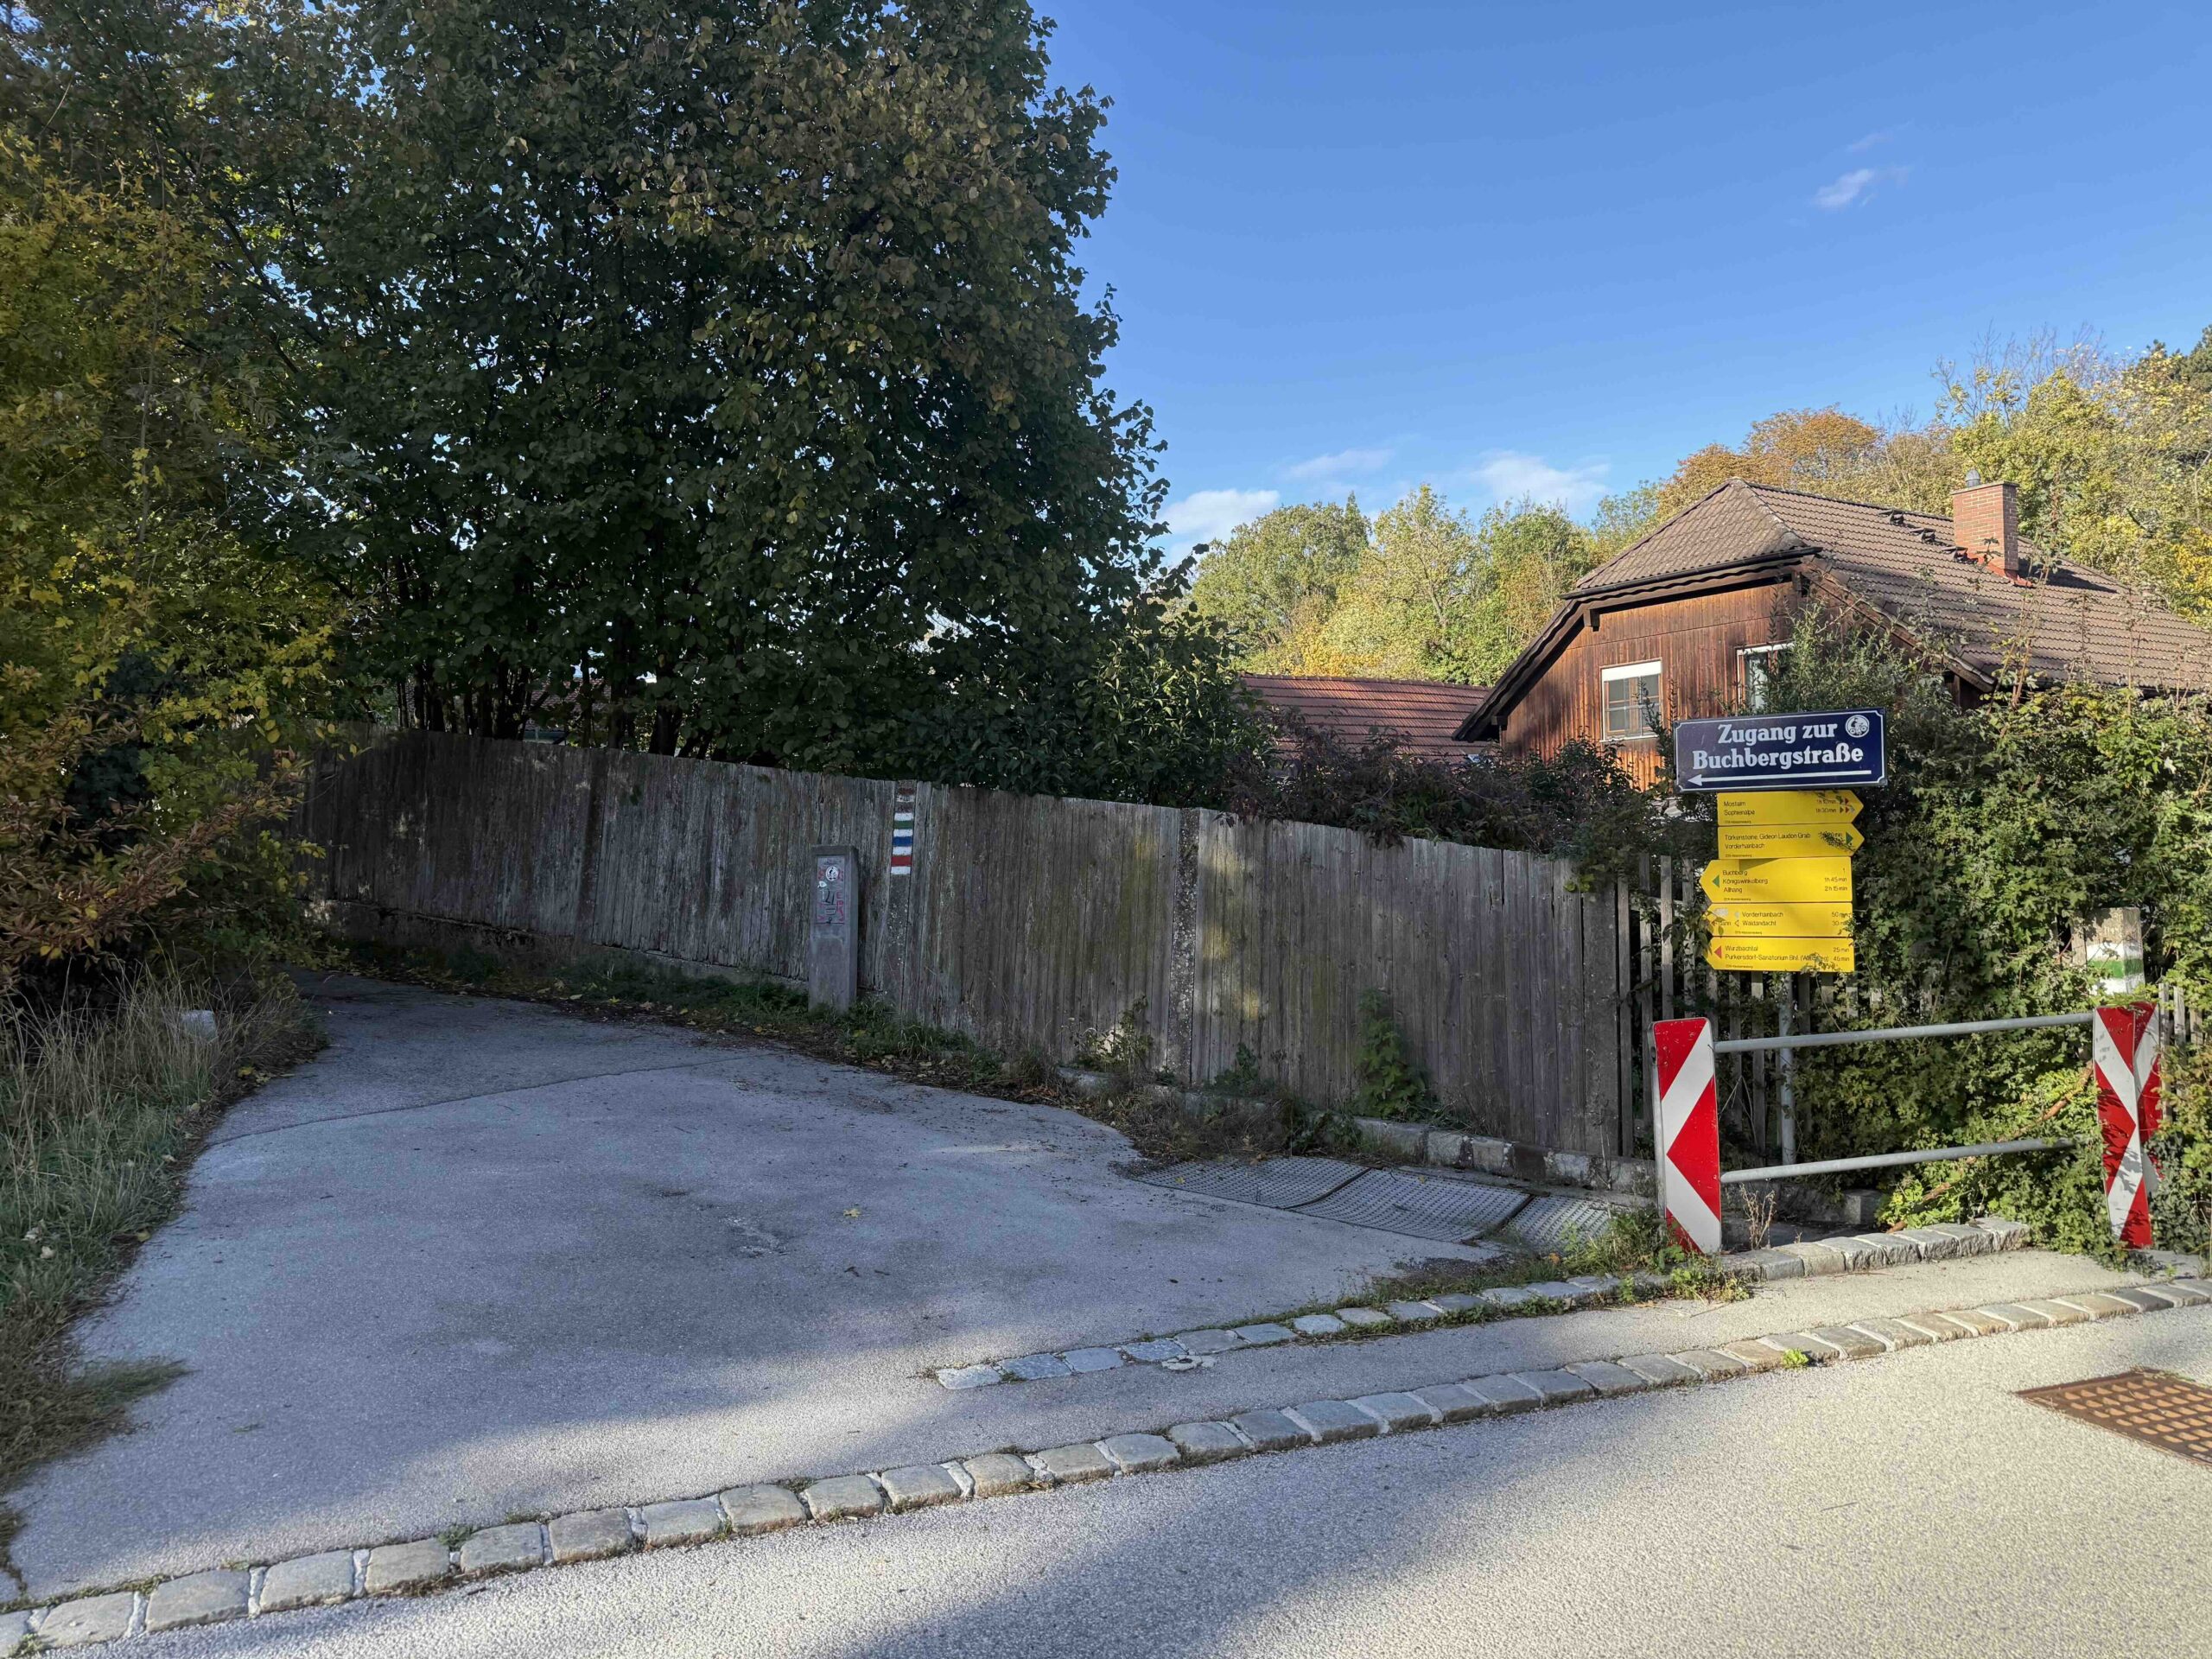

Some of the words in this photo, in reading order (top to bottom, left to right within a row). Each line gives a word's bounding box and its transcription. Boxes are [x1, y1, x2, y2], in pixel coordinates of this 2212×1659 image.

[1718, 723, 1796, 746] Zugang
[1802, 723, 1838, 739] zur
[1692, 742, 1864, 770] Buchbergstraße
